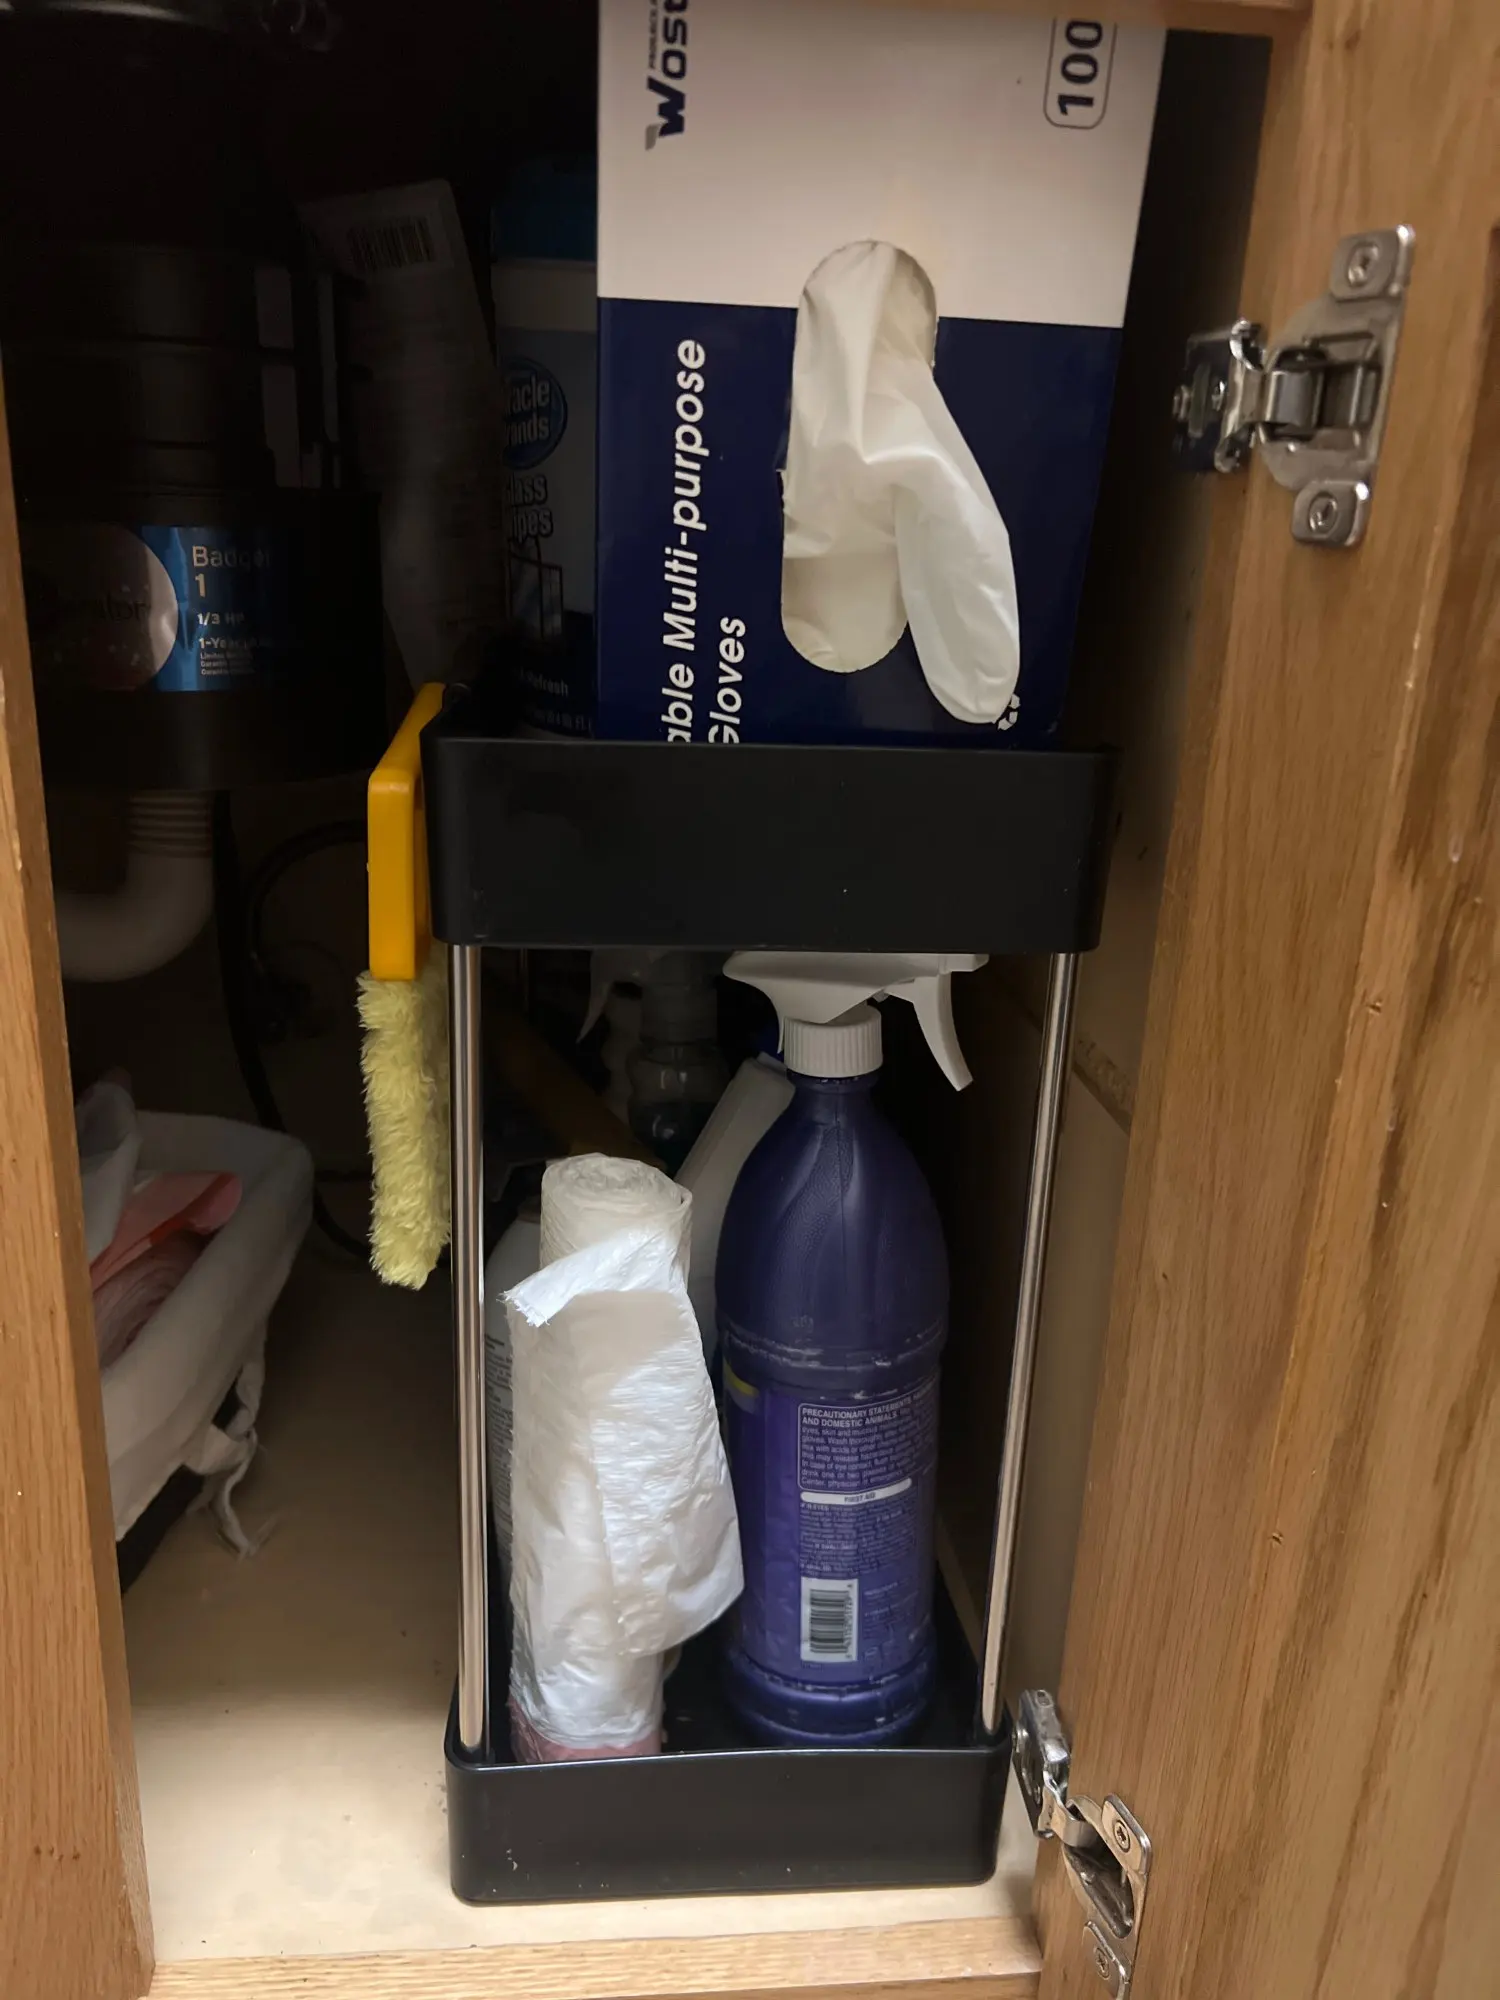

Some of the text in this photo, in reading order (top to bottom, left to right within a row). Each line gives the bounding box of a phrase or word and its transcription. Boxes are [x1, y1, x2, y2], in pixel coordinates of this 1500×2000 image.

[1056, 20, 1103, 117] 100
[509, 472, 548, 505] lass
[663, 339, 710, 651] Multi-purpose
[511, 507, 553, 545] ipes
[194, 573, 207, 598] 1
[197, 612, 221, 626] 1/3
[707, 617, 746, 744] Gloves
[802, 1408, 867, 1418] PRECAUTIONARY
[802, 1418, 819, 1426] AND
[821, 1419, 863, 1428] DOMESTIC
